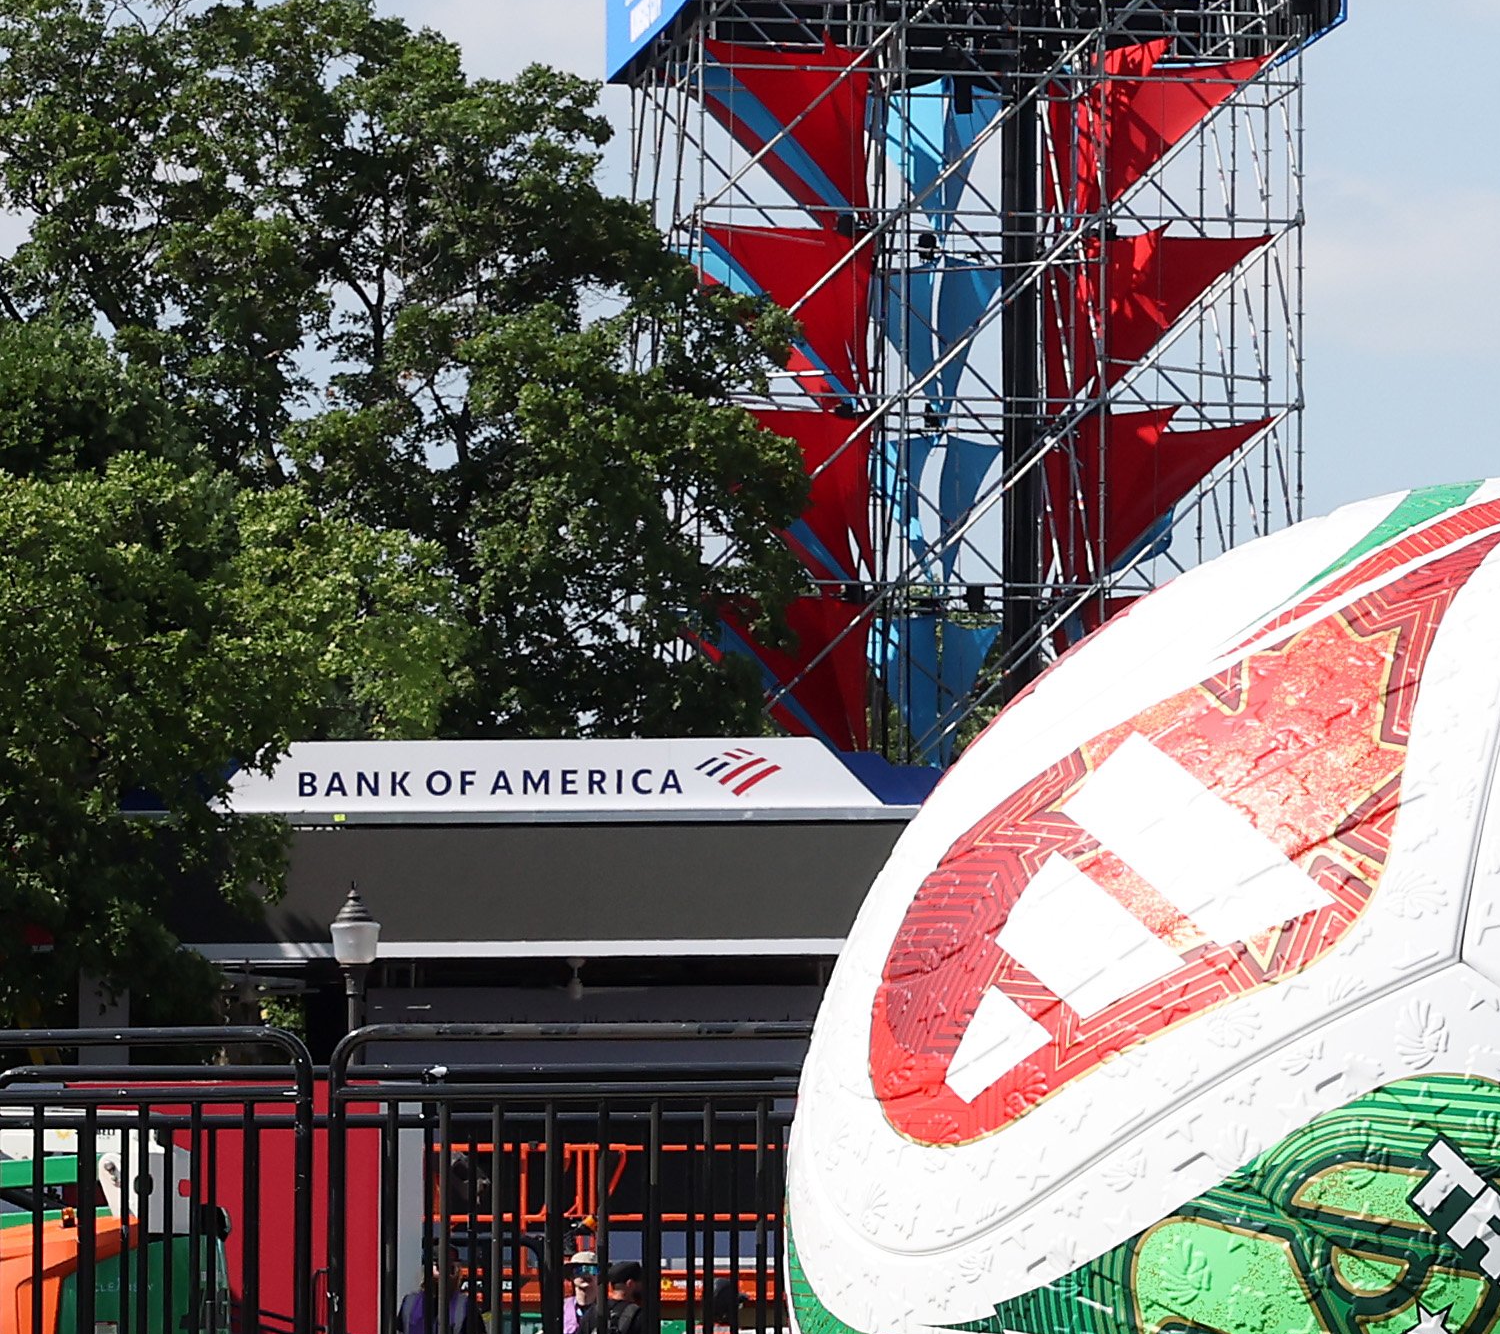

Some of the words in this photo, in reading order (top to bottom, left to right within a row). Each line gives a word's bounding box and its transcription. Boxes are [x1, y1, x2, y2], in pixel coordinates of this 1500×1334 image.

[299, 770, 412, 798] BANK
[425, 769, 477, 797] OF
[489, 768, 684, 796] AMERICA
